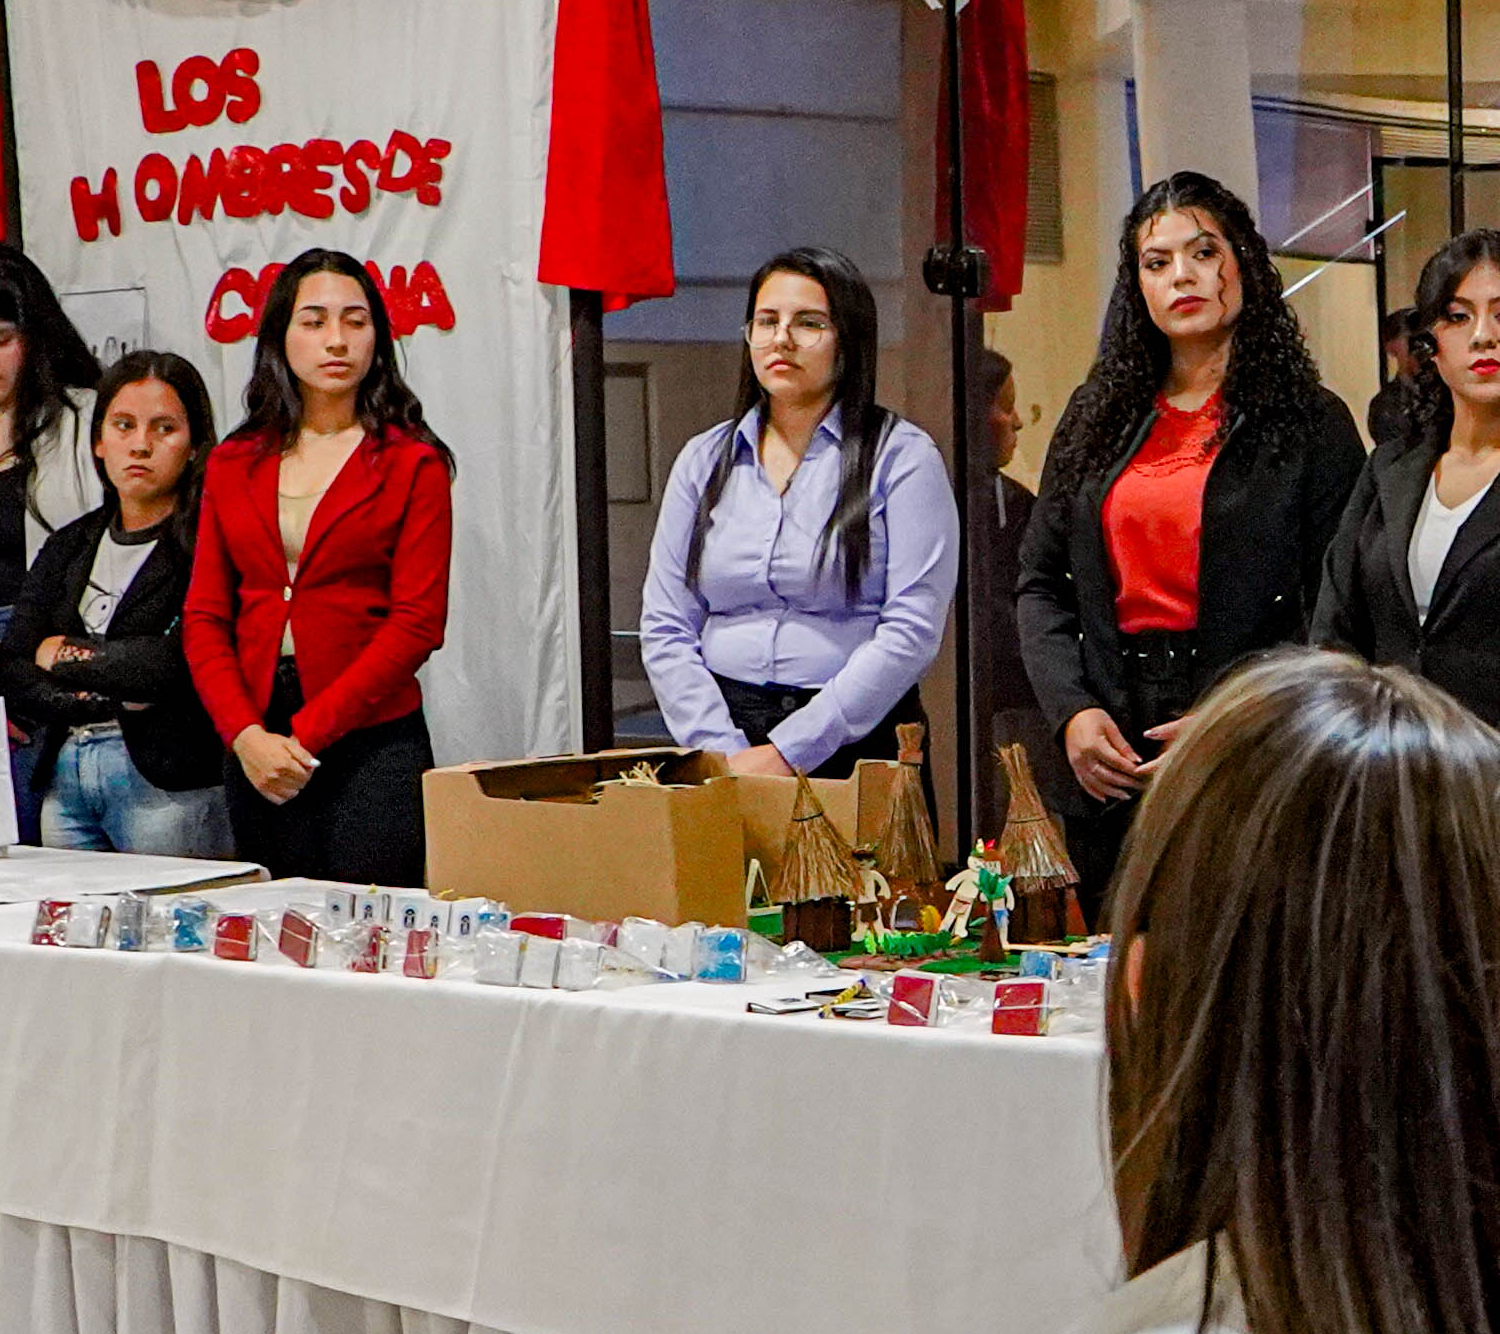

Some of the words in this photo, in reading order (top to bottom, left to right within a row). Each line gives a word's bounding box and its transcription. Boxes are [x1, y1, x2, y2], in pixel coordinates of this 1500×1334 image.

[134, 47, 261, 134] LOS
[70, 138, 381, 243] HOMBRES
[376, 128, 453, 207] DE
